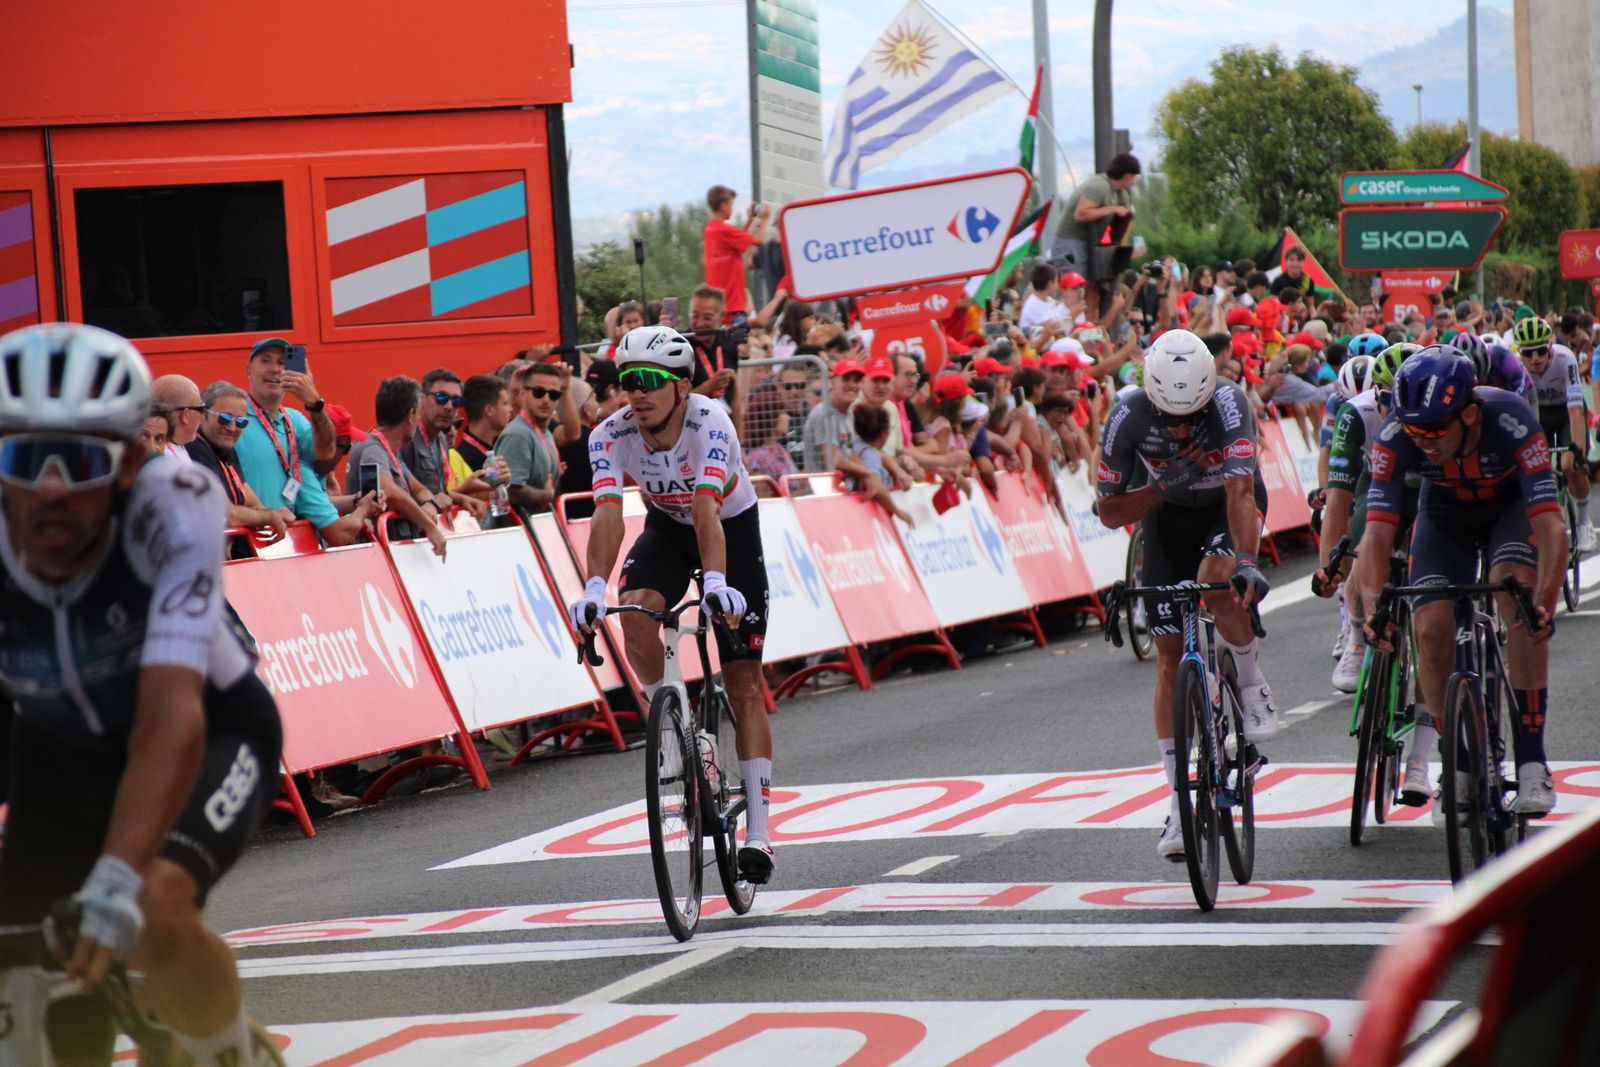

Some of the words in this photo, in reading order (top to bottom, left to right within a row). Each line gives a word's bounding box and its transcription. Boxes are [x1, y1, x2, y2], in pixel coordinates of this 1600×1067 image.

[1358, 180, 1404, 195] caser
[1403, 186, 1428, 194] Grupo
[802, 226, 935, 263] Carrefour
[1385, 278, 1423, 287] Carrefour
[863, 302, 921, 319] Carrefour
[1214, 385, 1242, 431] Alpecin
[1228, 443, 1255, 454] Alpec
[646, 476, 696, 495] UAE
[906, 523, 977, 576] Carrefour
[420, 589, 524, 662] Carrefour
